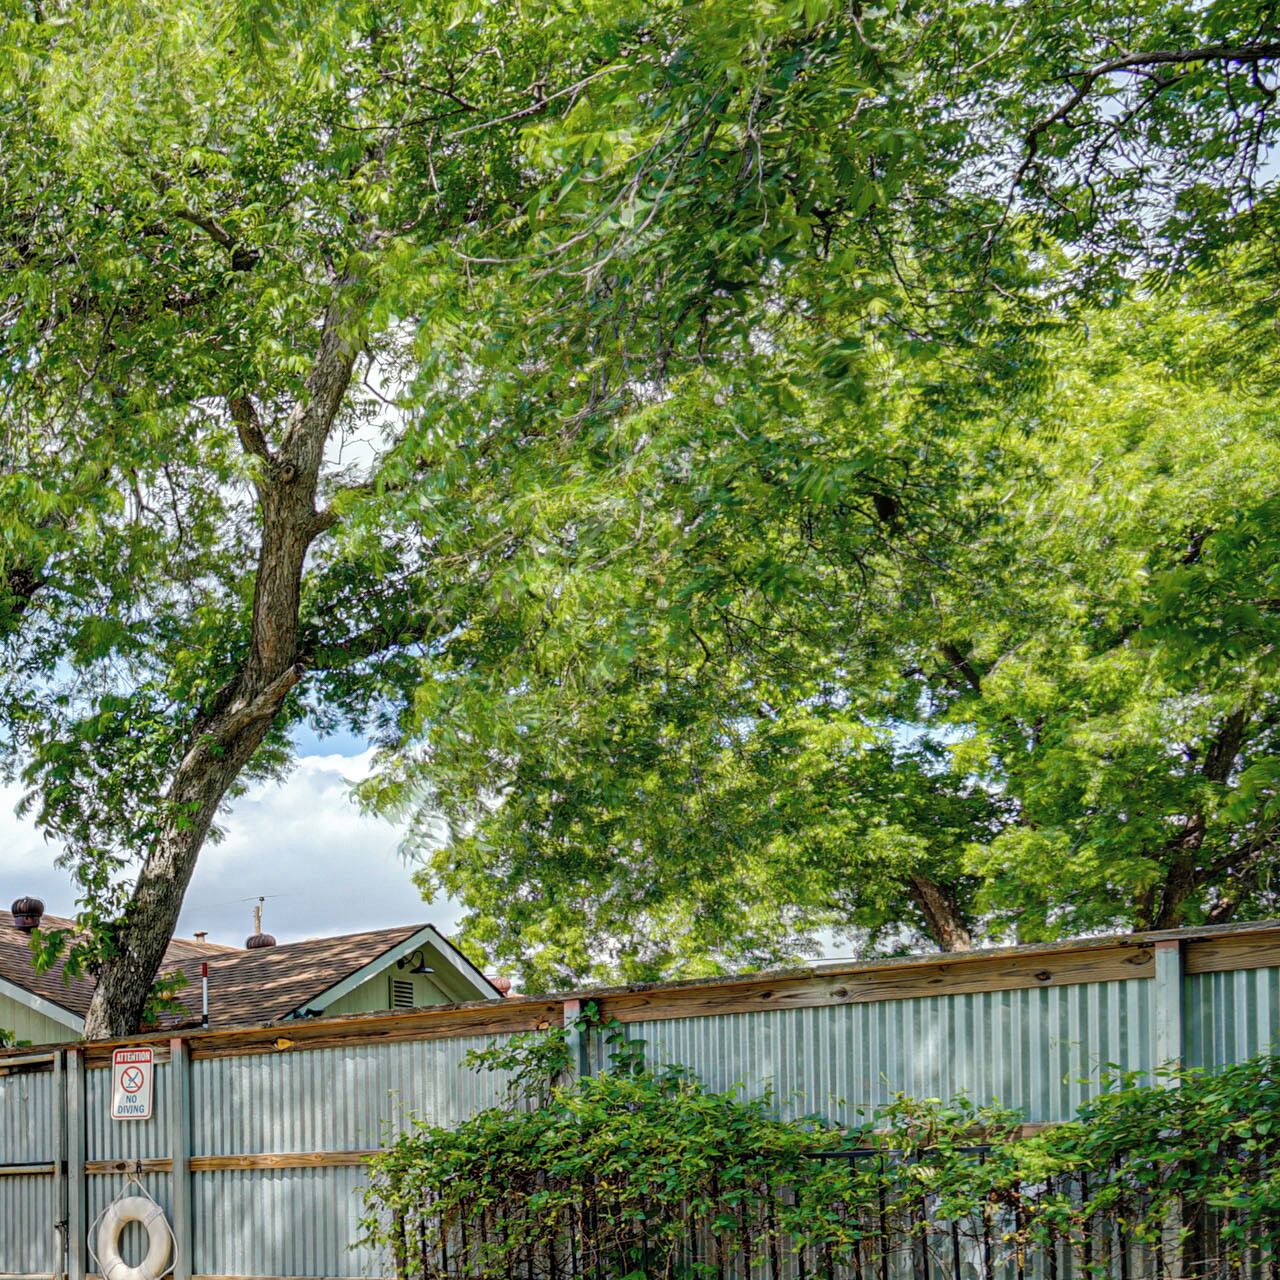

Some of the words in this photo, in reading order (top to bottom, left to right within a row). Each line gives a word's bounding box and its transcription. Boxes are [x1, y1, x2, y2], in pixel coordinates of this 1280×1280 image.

[116, 1052, 150, 1062] ATTENTION
[126, 1095, 137, 1103] NO
[117, 1104, 145, 1114] DIVING
